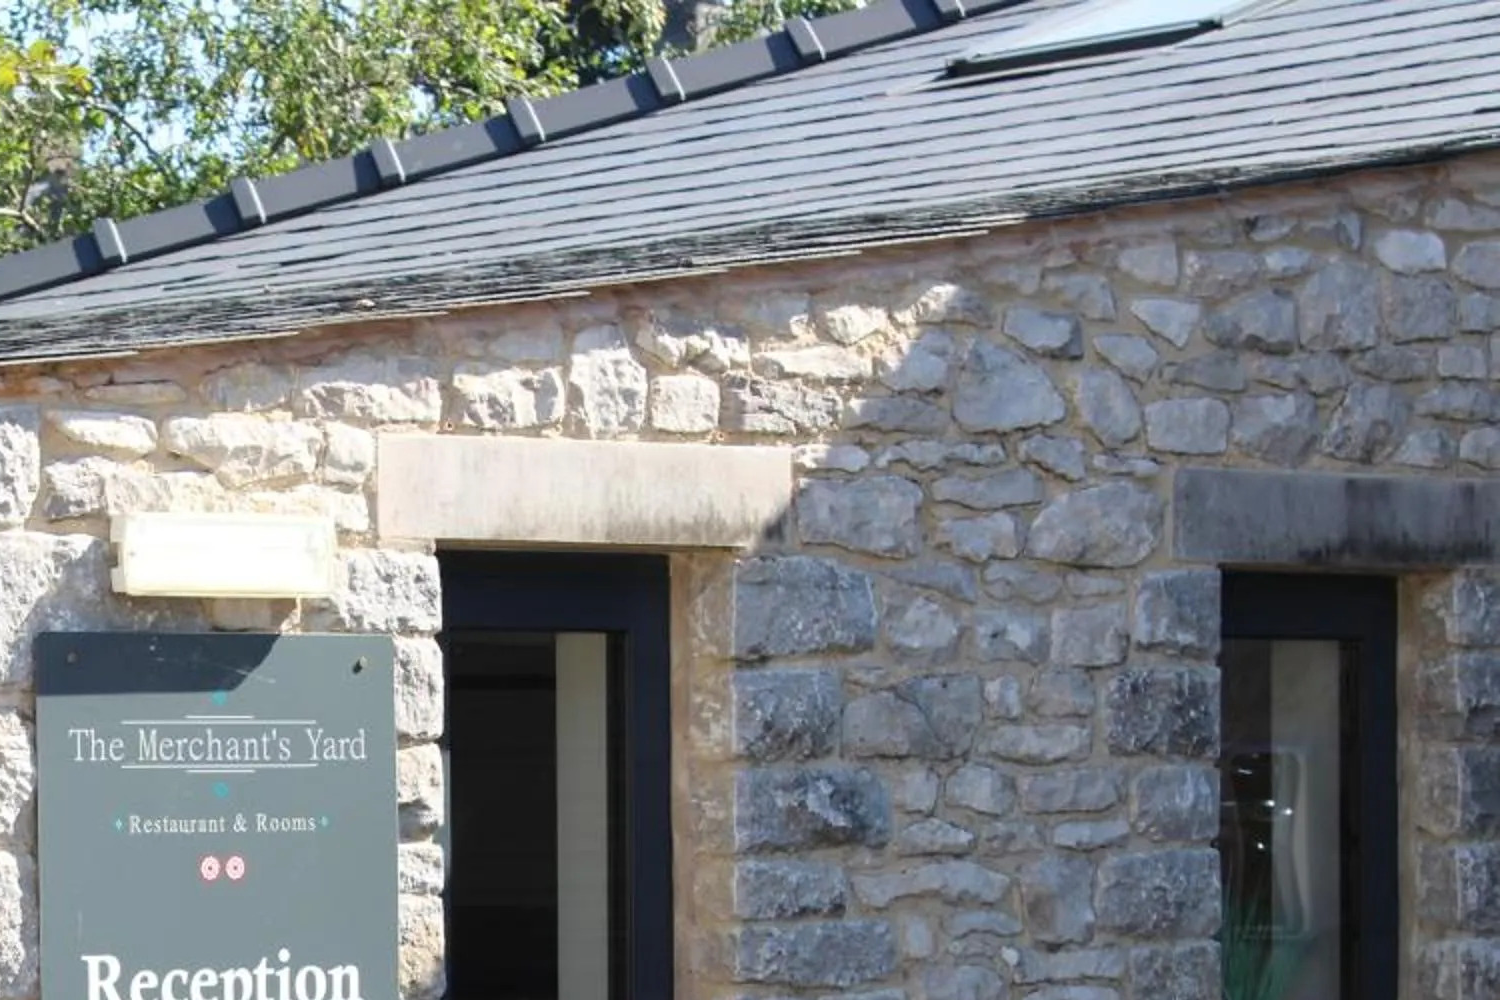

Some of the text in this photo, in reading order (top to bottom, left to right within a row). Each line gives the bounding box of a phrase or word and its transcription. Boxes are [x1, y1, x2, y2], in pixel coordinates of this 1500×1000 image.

[68, 727, 367, 762] The Merchant's Yard
[129, 812, 317, 833] Restaurant & Rooms
